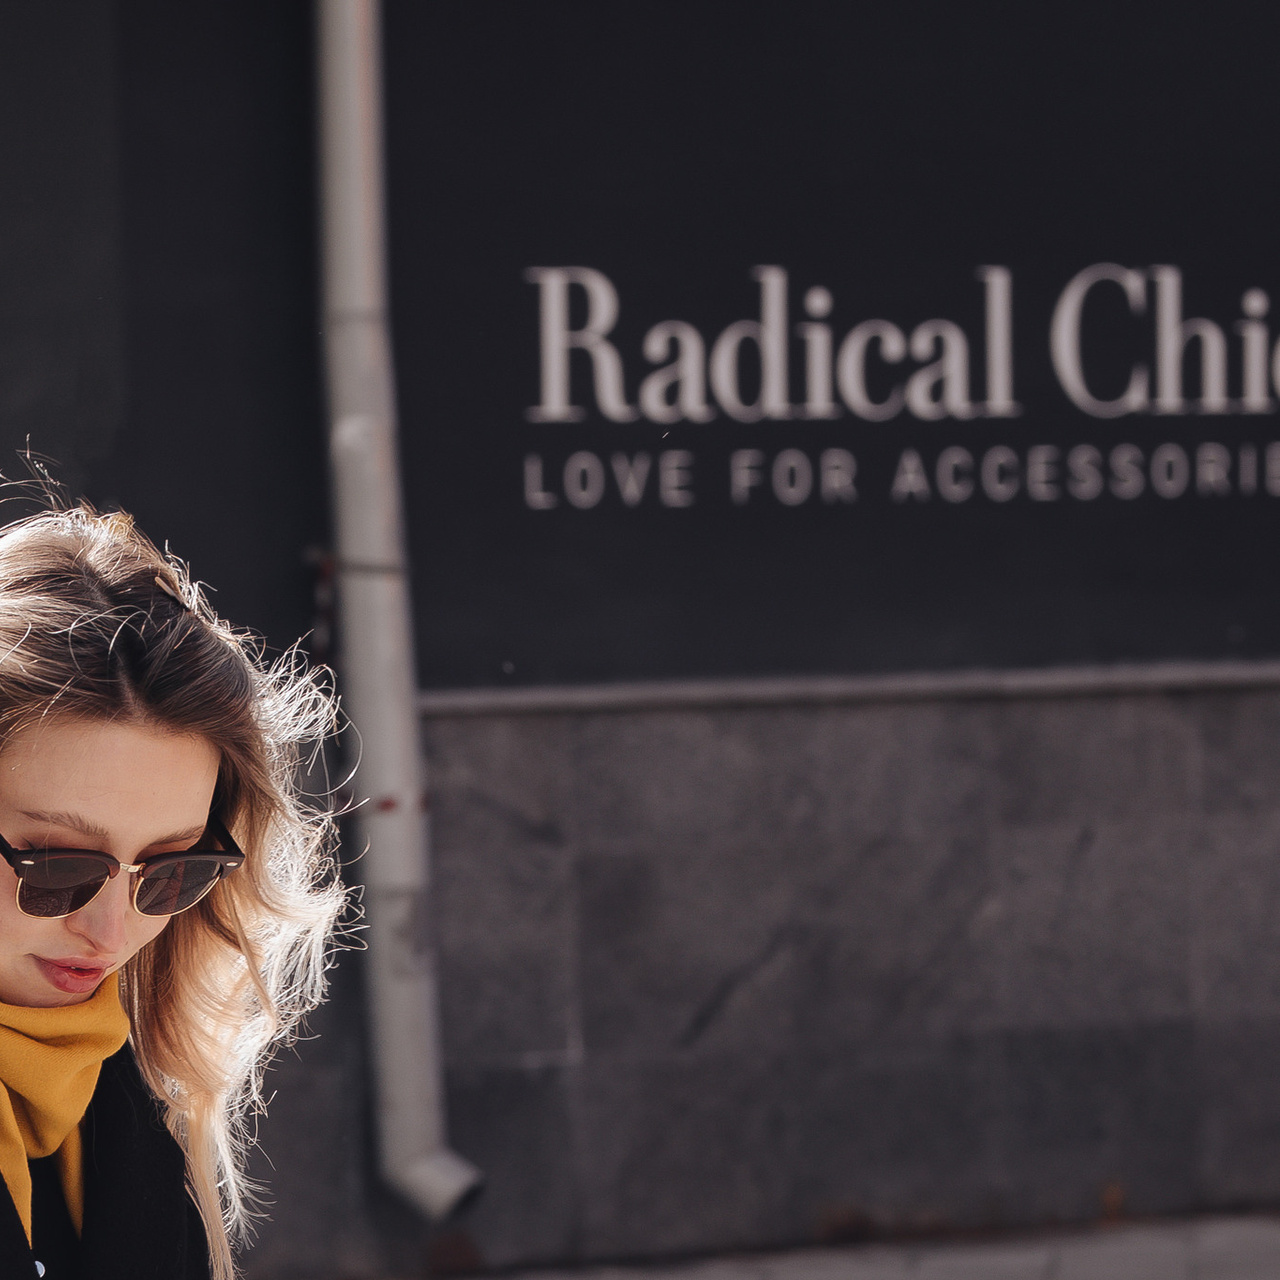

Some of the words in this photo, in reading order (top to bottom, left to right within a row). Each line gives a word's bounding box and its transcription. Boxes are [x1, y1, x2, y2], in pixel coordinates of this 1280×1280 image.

[524, 263, 1024, 423] Radical
[1050, 261, 1280, 419] Chi
[523, 448, 697, 510] LOVE
[730, 446, 859, 506] FOR
